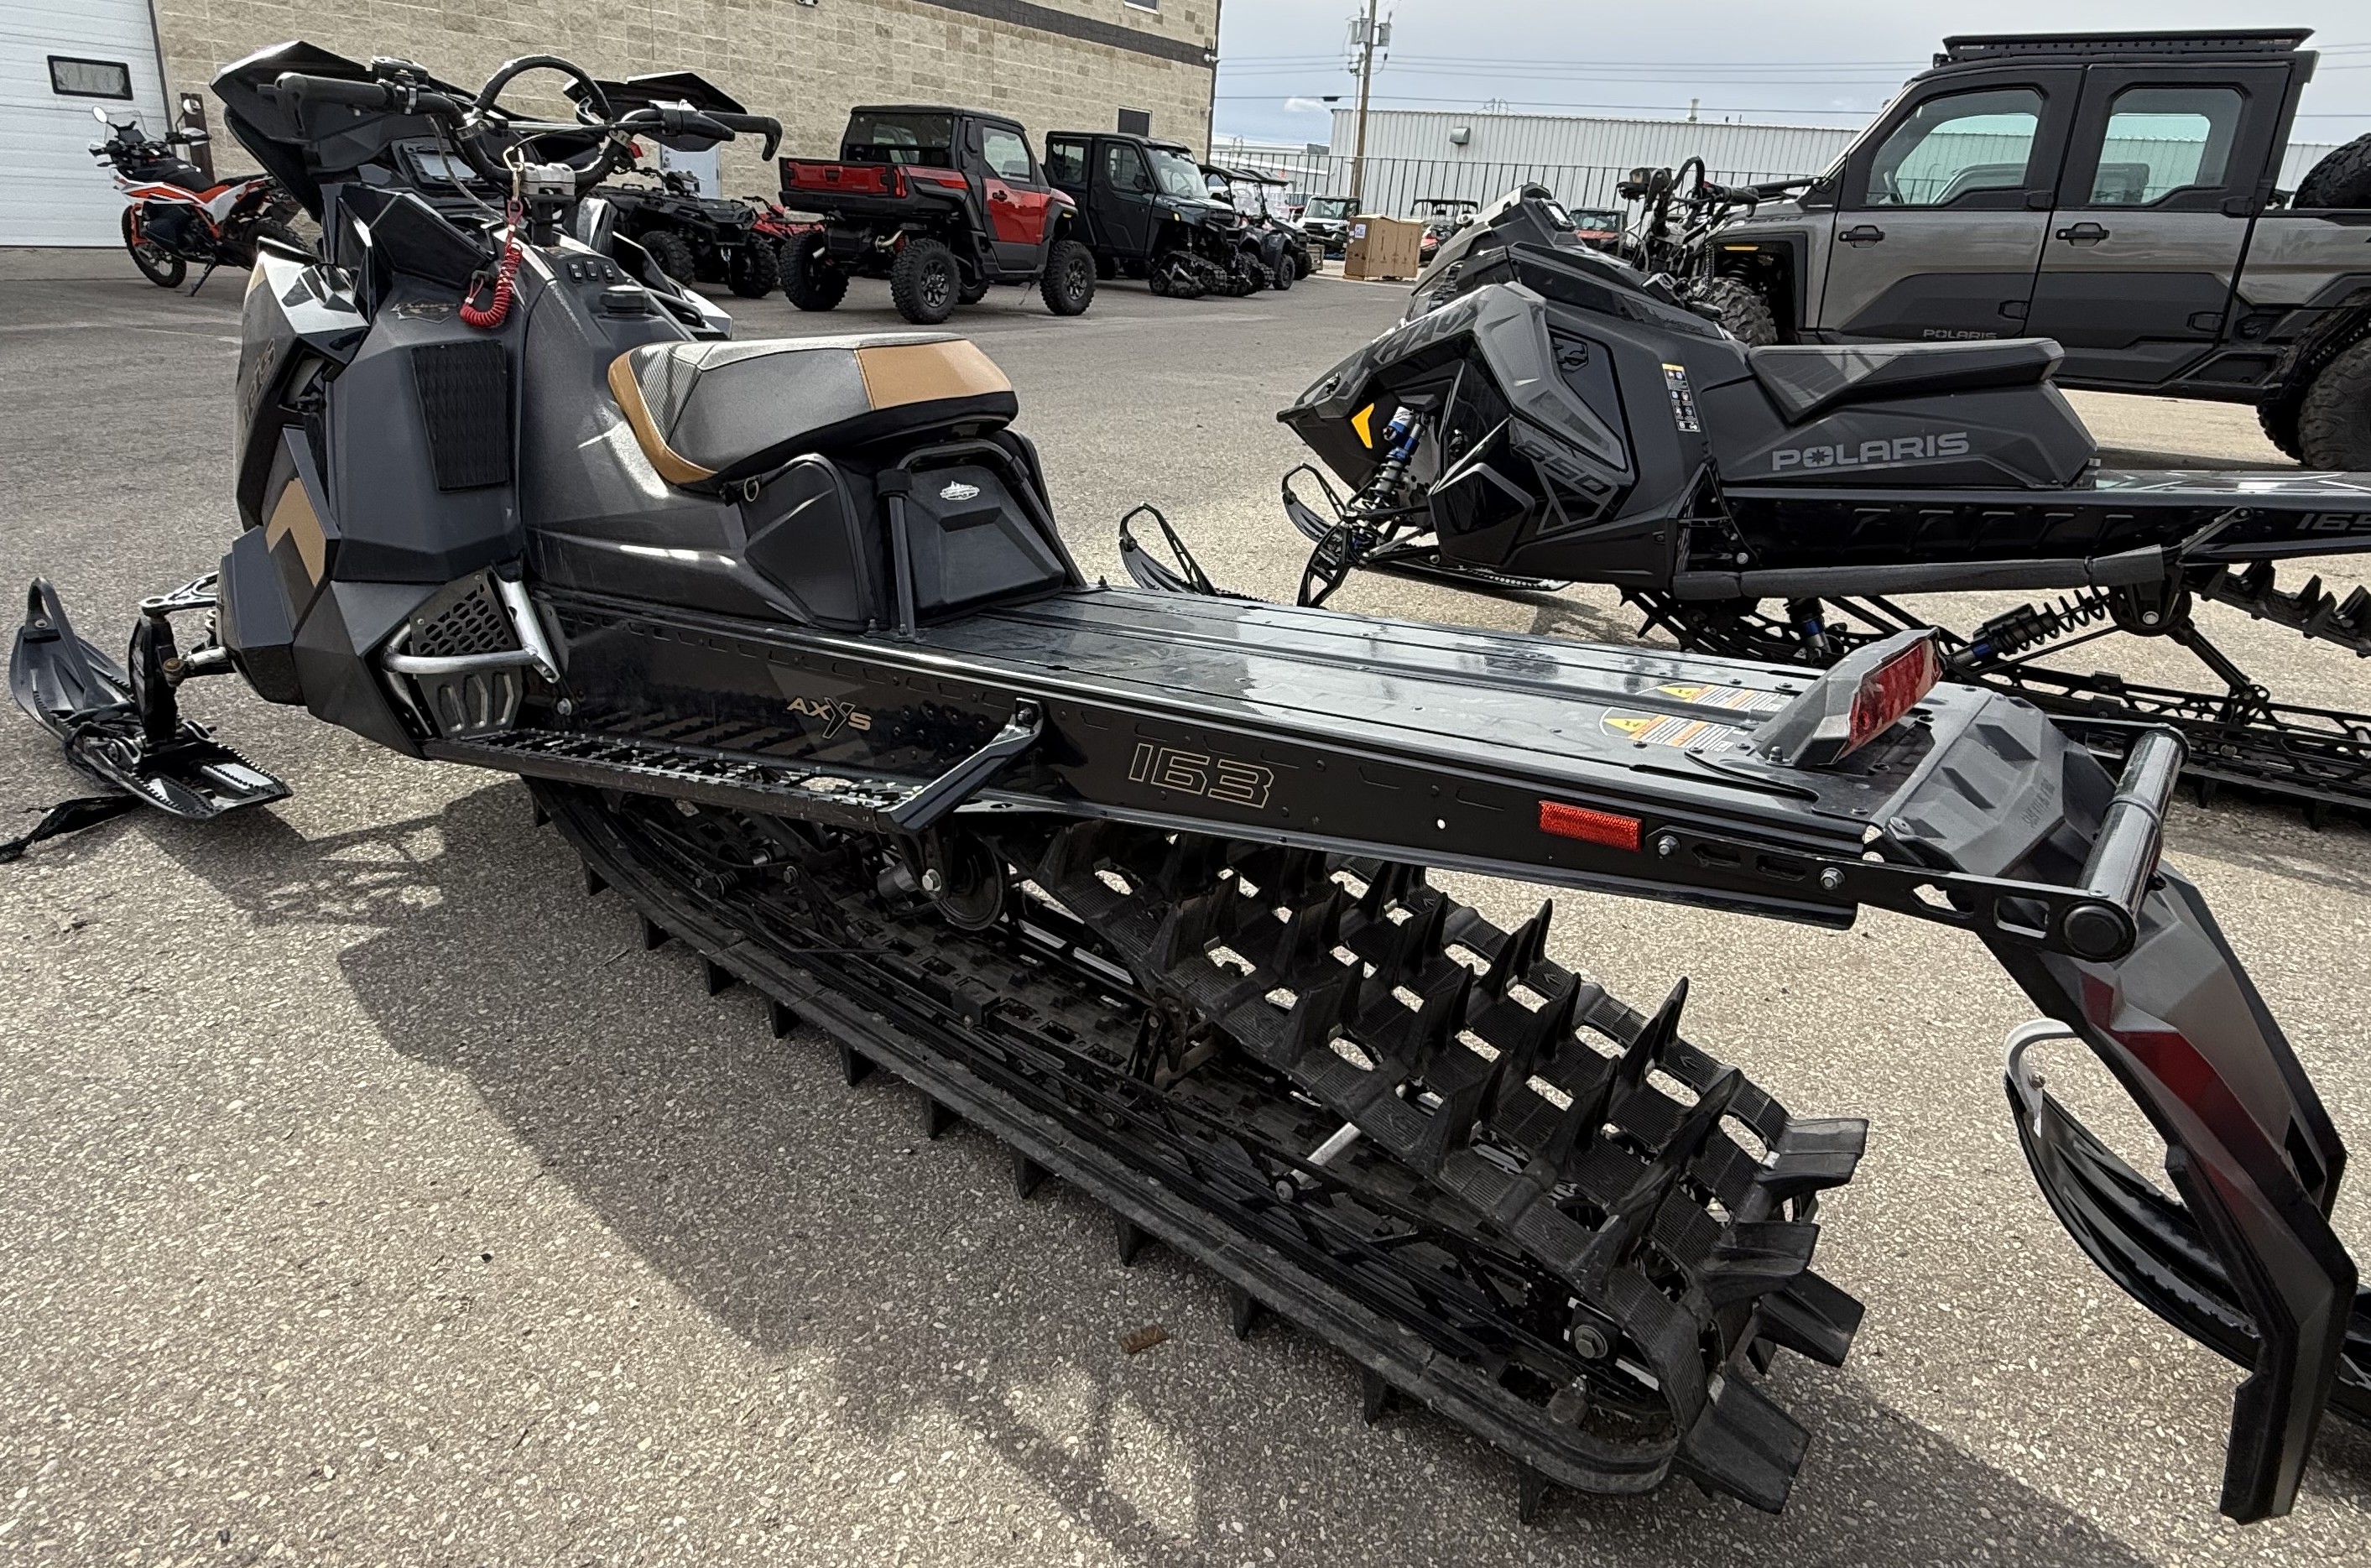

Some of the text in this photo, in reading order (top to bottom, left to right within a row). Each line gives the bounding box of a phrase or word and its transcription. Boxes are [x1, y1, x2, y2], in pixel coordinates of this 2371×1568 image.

[1923, 329, 1998, 339] POLARIS
[1772, 431, 1970, 471] POLARIS
[786, 696, 873, 739] AXYS
[1128, 742, 1275, 810] 163
